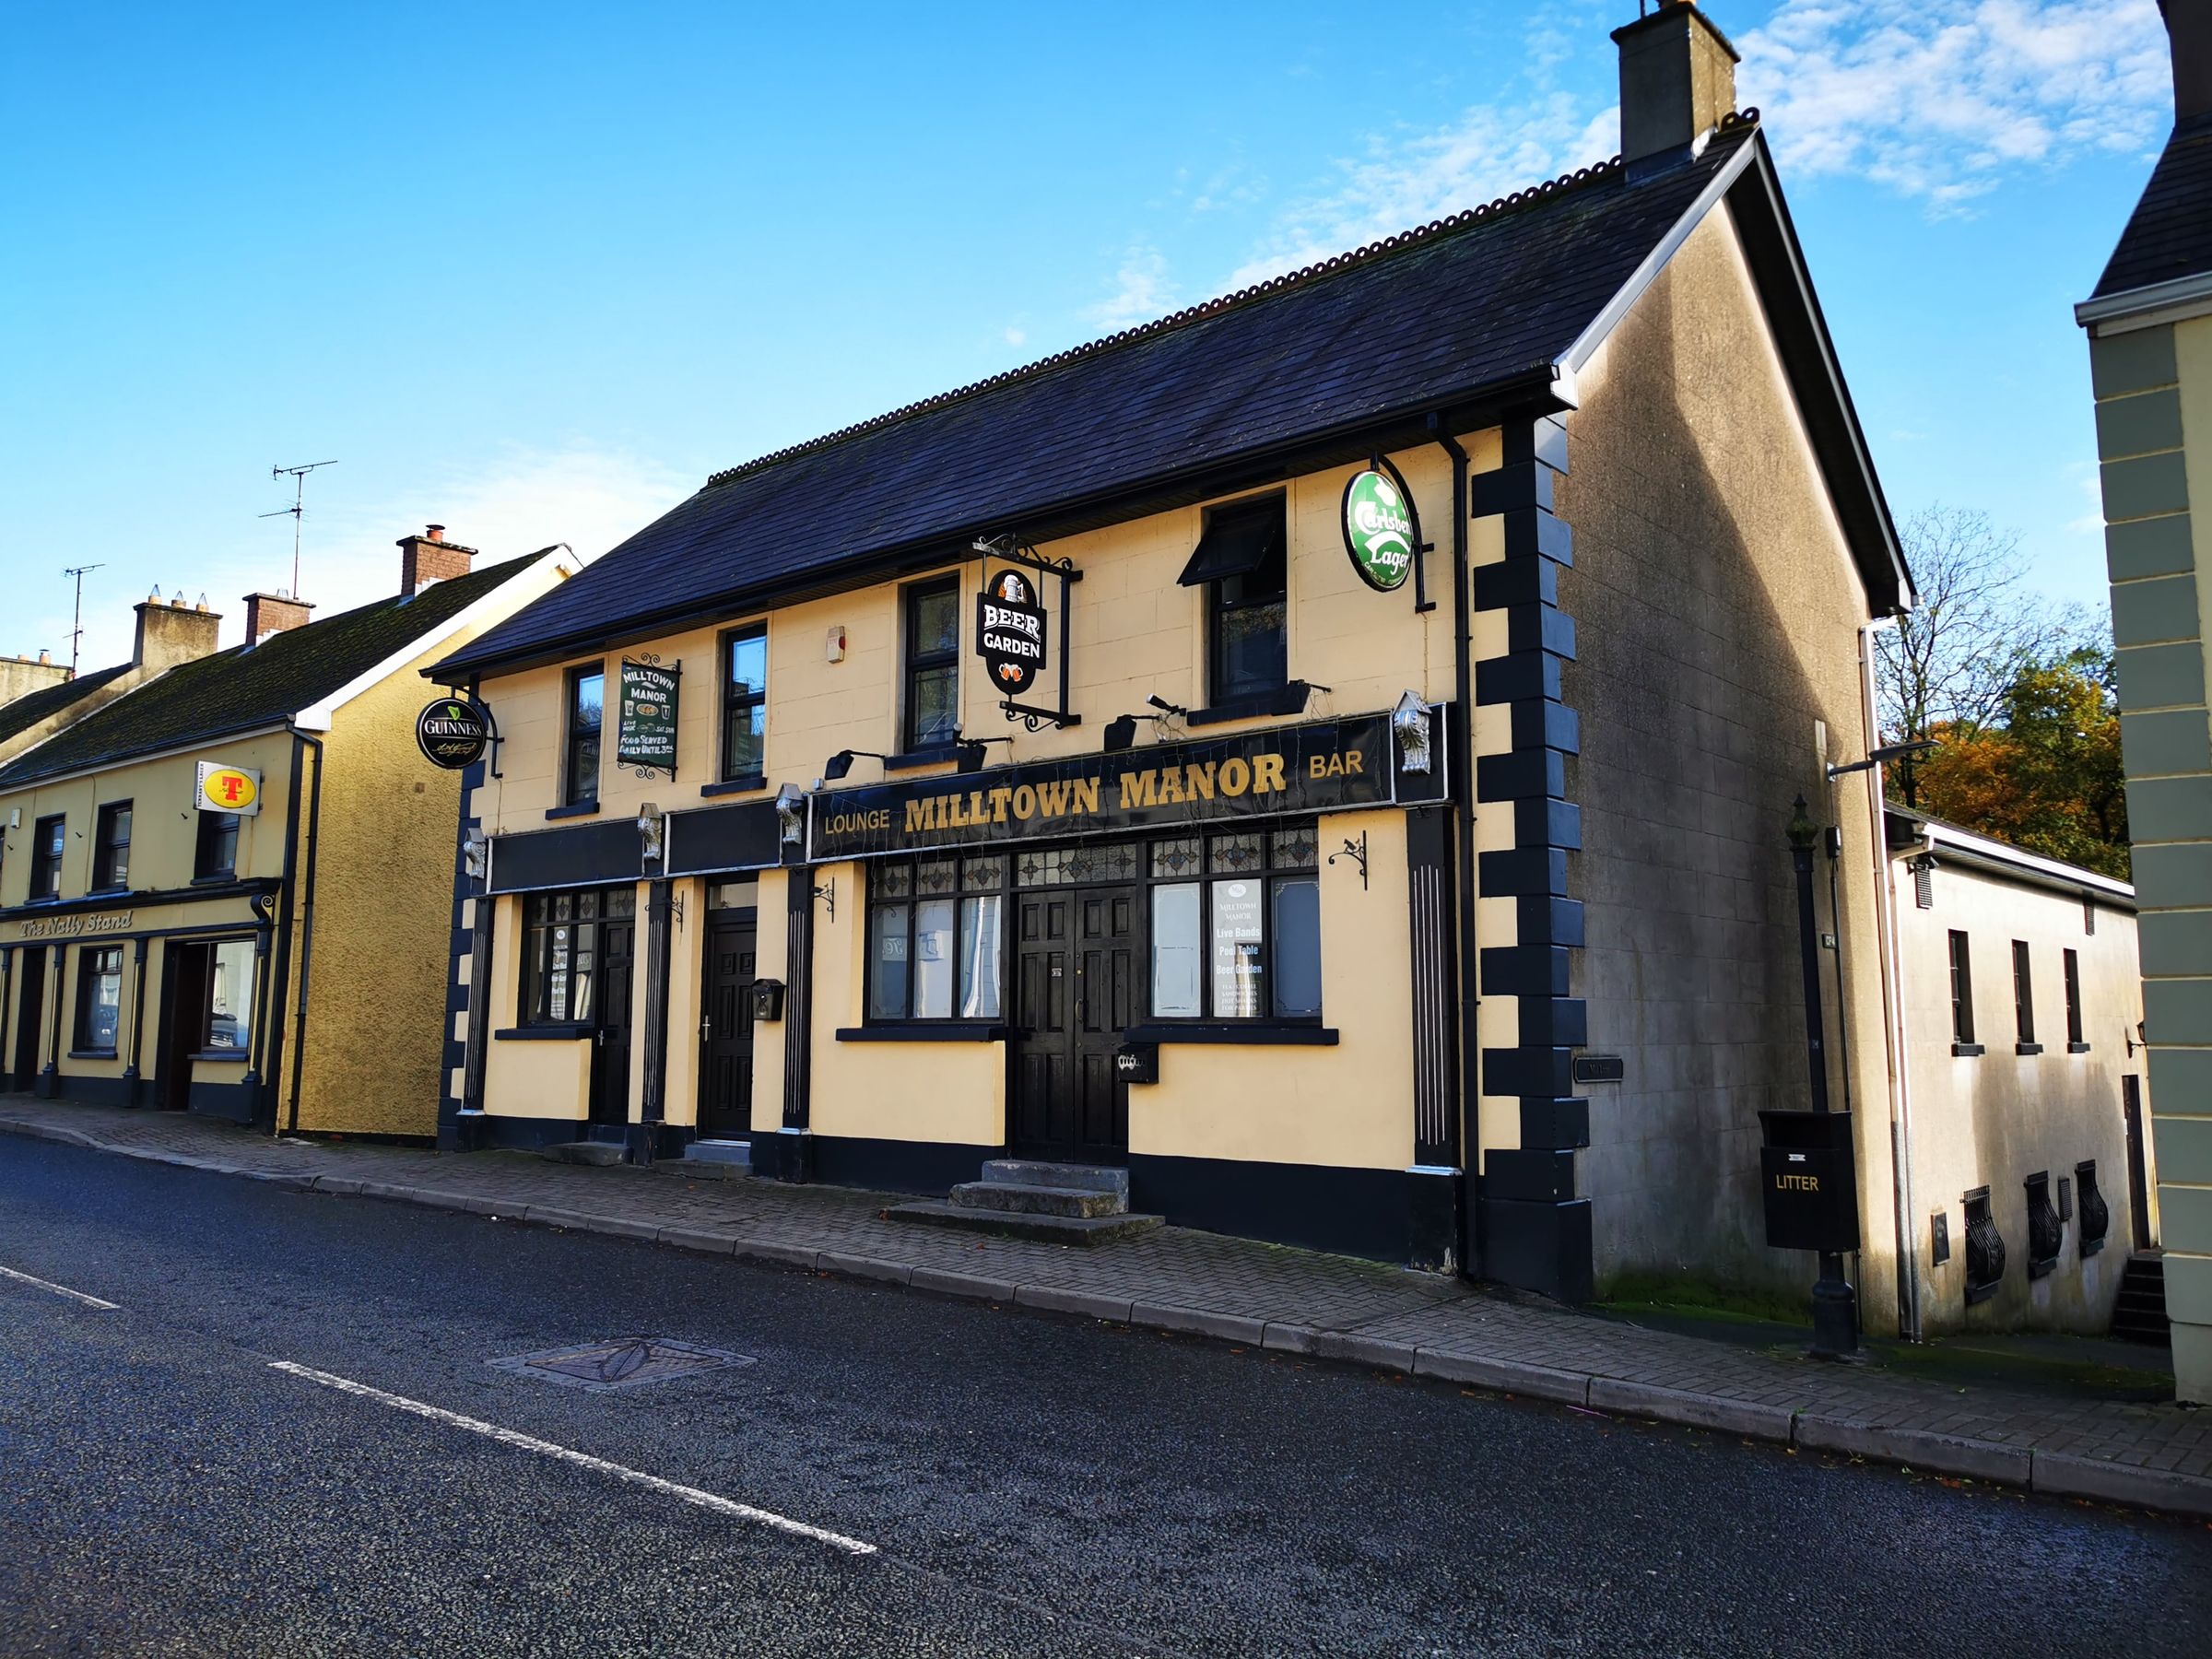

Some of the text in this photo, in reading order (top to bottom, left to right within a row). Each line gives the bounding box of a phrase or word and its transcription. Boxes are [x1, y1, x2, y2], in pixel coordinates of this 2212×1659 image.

[1355, 501, 1411, 535] Carlsber
[1371, 550, 1408, 576] Lager
[983, 604, 1041, 640] BEER
[983, 632, 1040, 658] GARDEN
[623, 671, 676, 690] MILLTOWN
[631, 688, 666, 703] MANOR
[424, 720, 482, 736] GUINNESS
[620, 735, 667, 745] FOOD SERVED
[641, 745, 660, 754] UNTIL
[222, 776, 242, 801] T
[825, 749, 1364, 835] LOUNGE MILLTOWN MANOR BAR
[1219, 902, 1257, 912] MILLTOWN
[19, 910, 133, 937] The Nally Stand
[1225, 912, 1252, 922] MANOR
[1217, 926, 1261, 938] Live Bands
[1219, 945, 1258, 956] Pool Table
[1217, 964, 1262, 974] Beer Garden
[1776, 1174, 1819, 1191] LITTER
